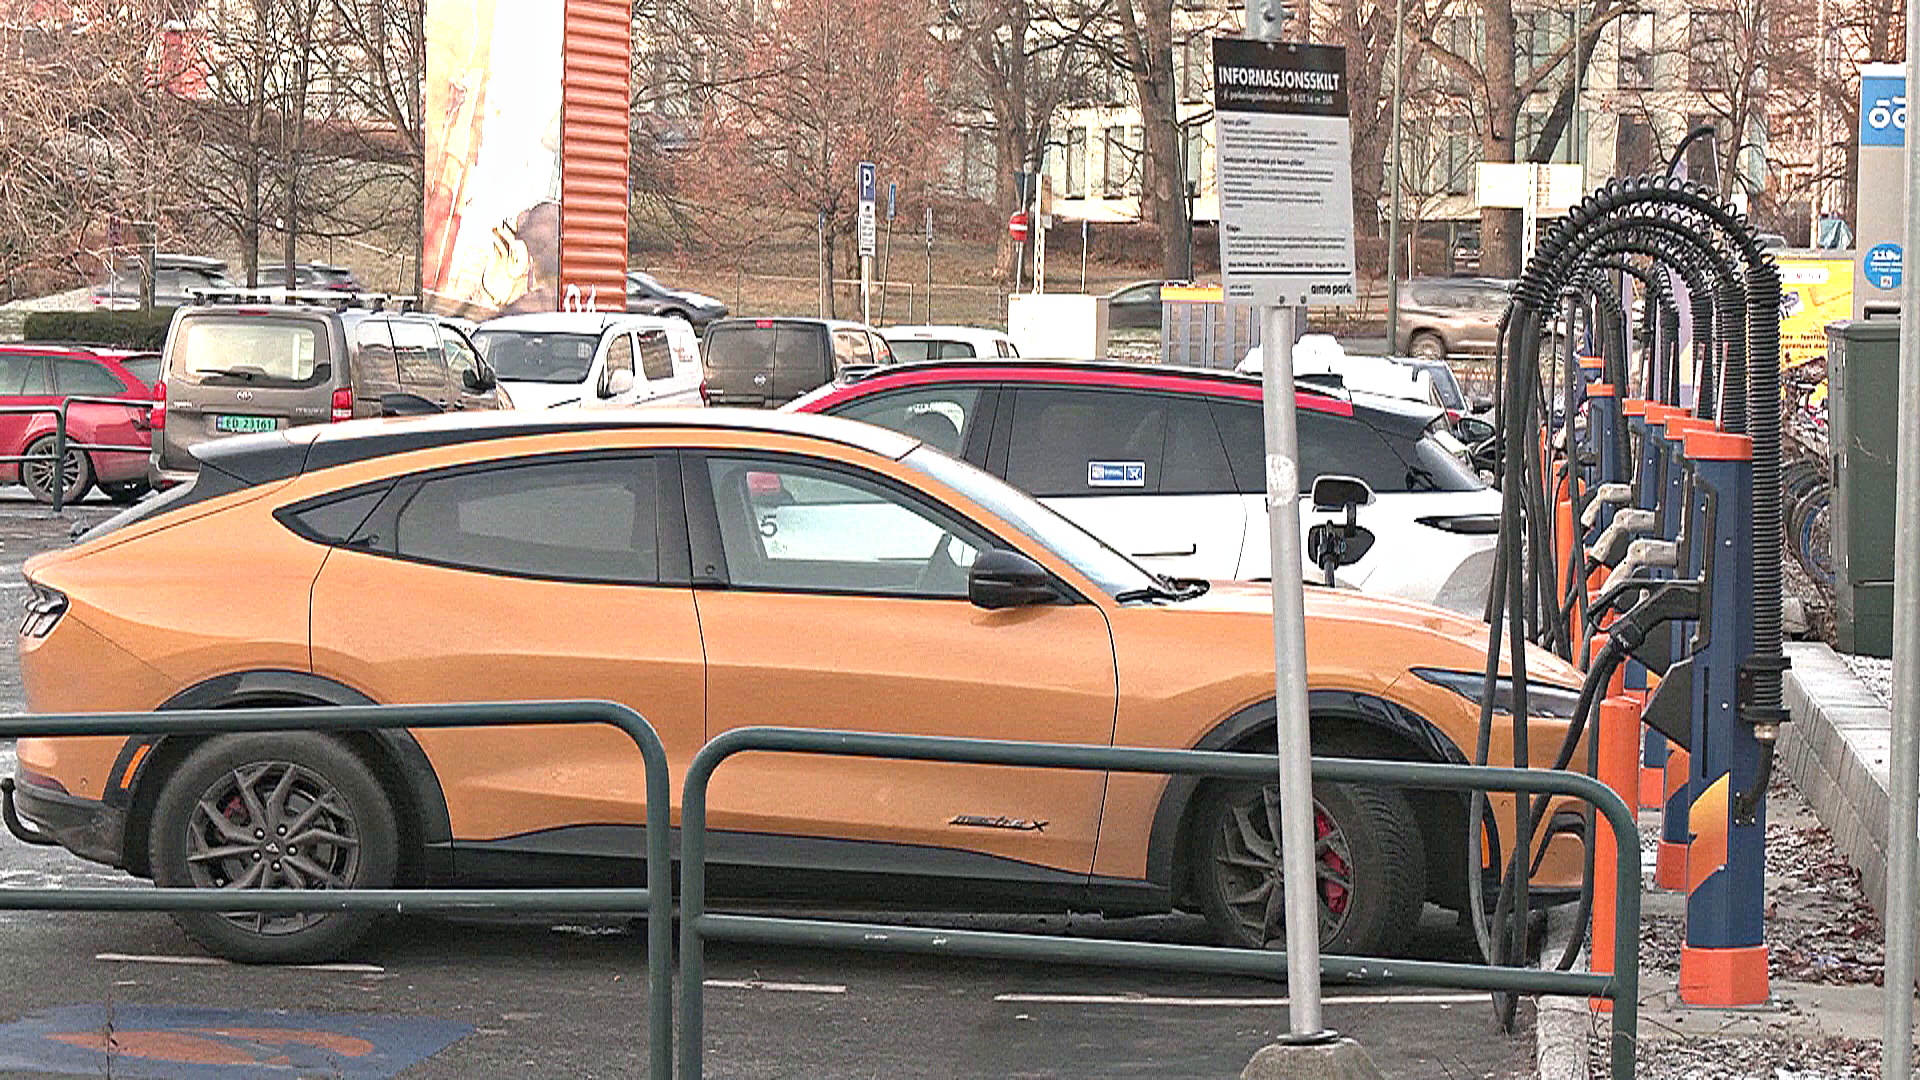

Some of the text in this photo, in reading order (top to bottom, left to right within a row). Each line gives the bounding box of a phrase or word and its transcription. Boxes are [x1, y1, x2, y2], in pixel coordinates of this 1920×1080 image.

[1218, 67, 1339, 91] INFORMASJONSSKILT
[863, 168, 872, 197] P
[1311, 283, 1352, 296] aimo park
